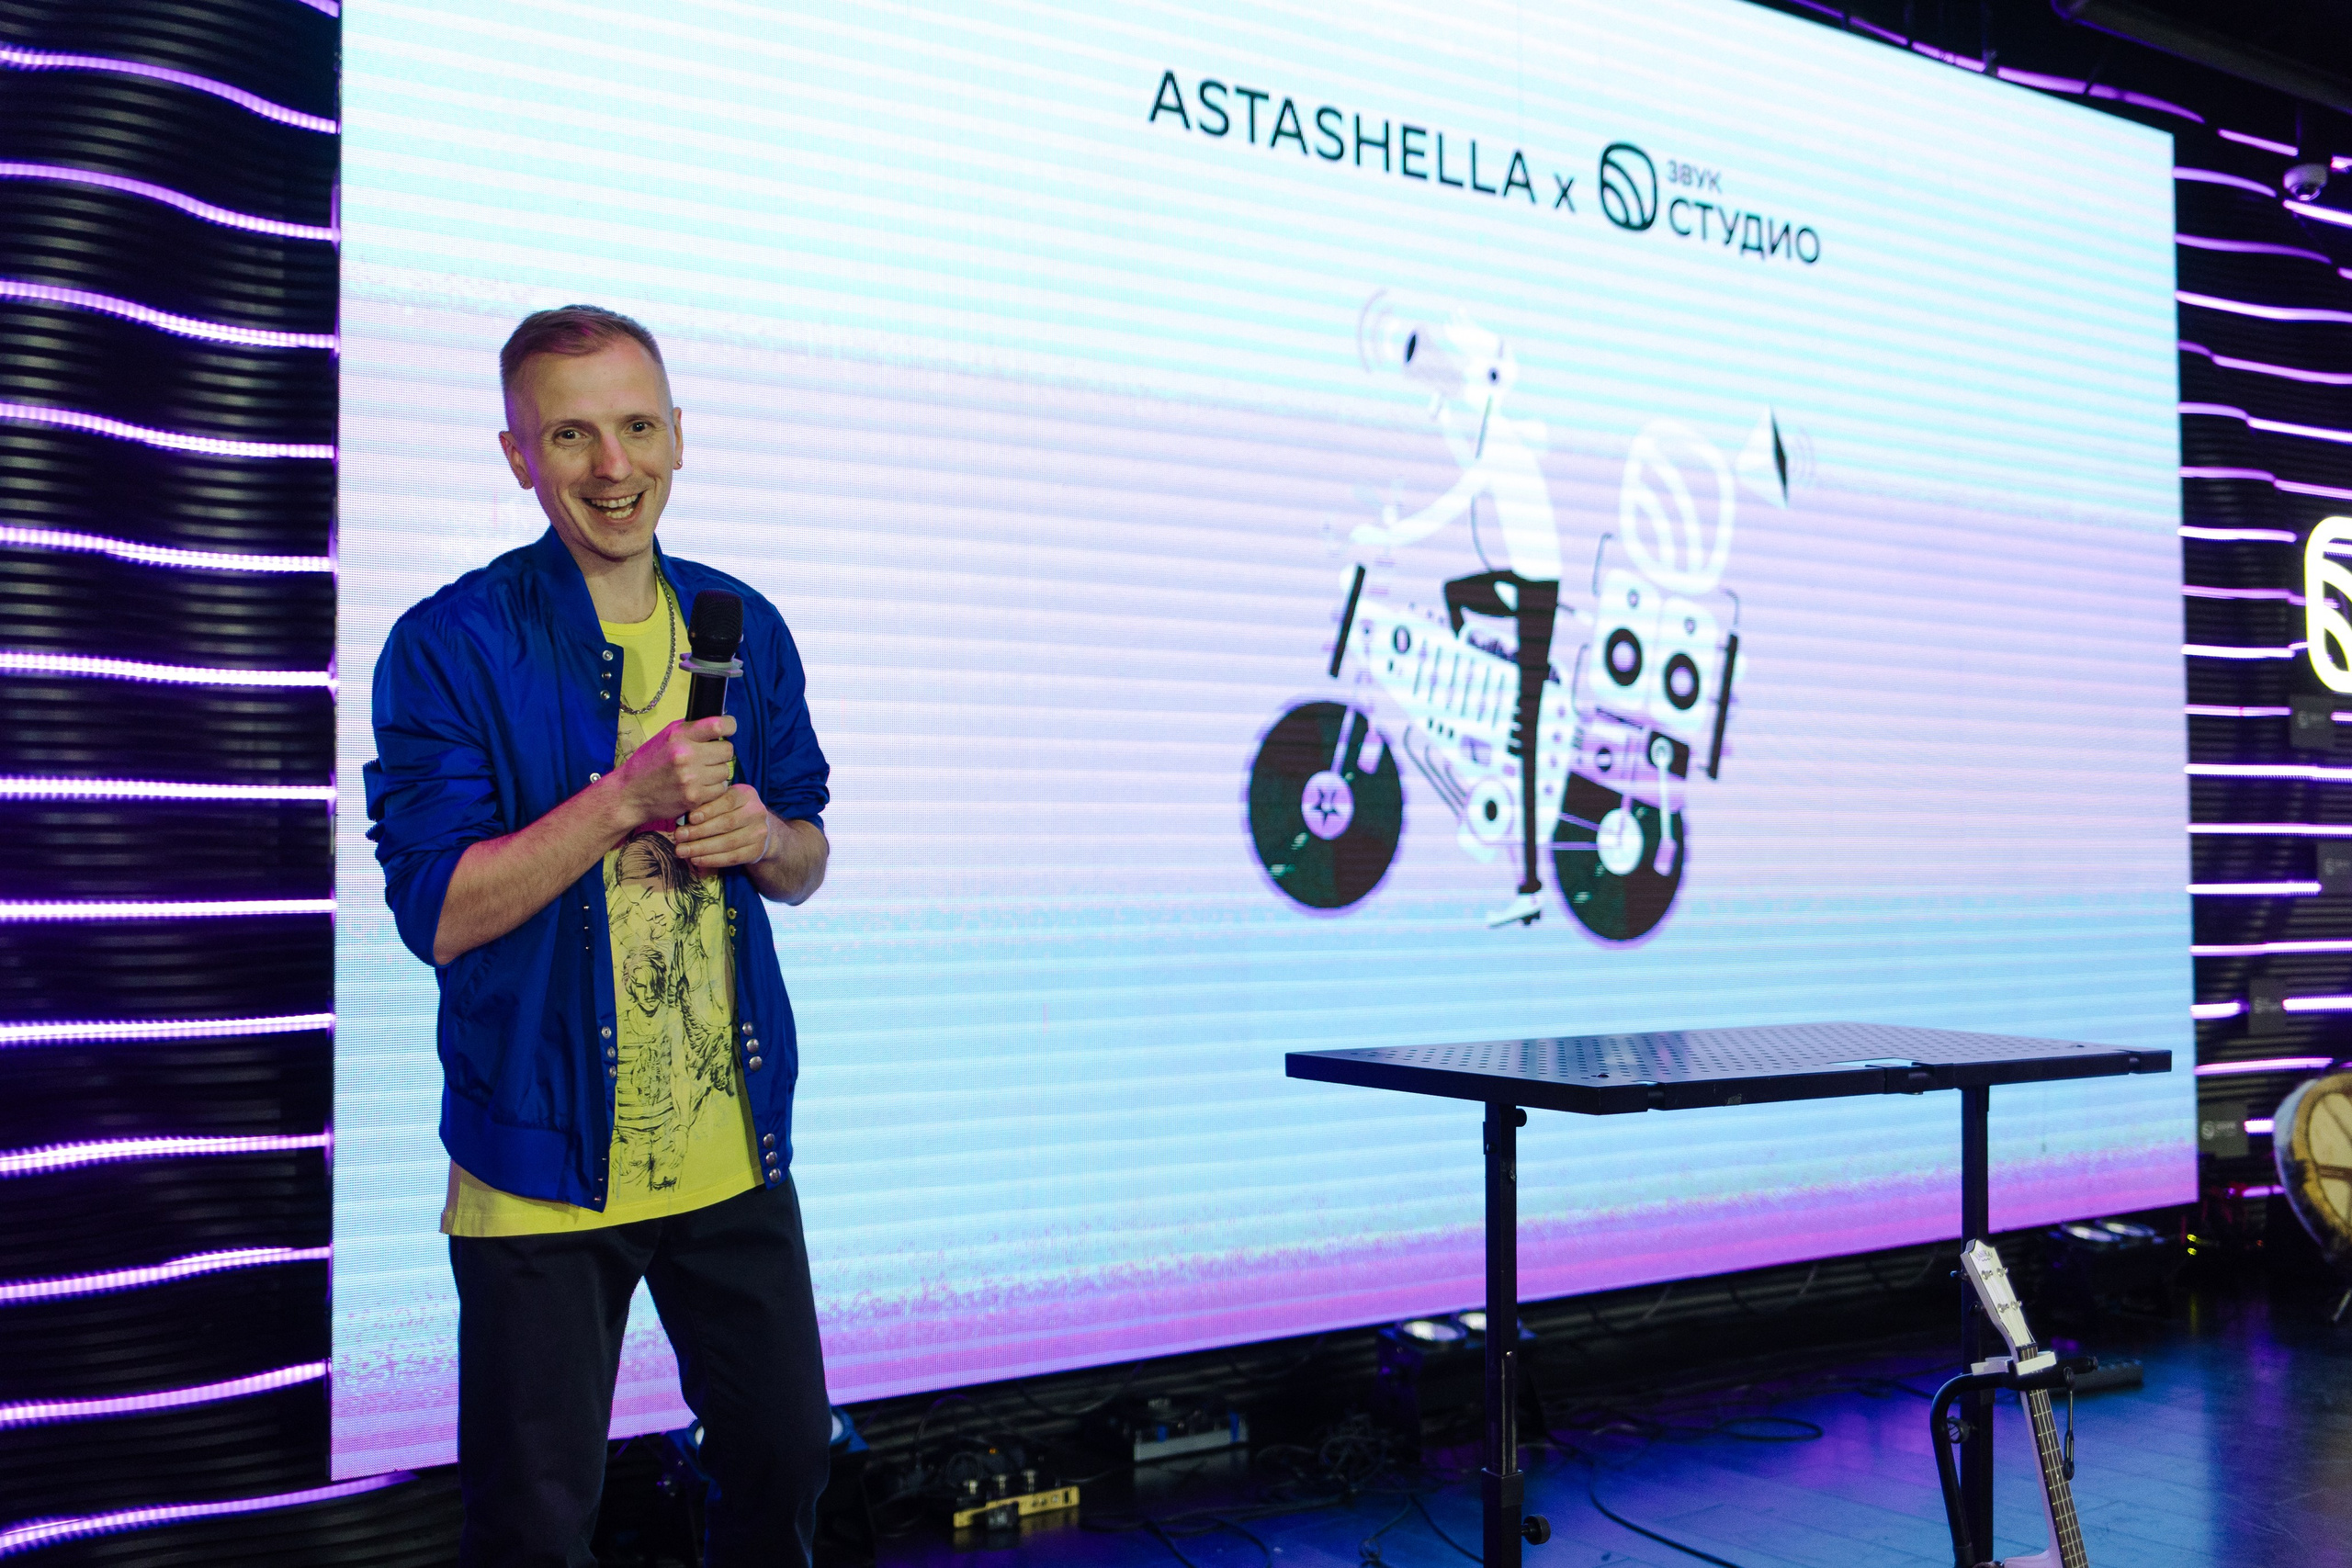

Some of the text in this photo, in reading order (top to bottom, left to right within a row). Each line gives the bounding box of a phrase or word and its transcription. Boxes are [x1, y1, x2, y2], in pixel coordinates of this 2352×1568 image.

[1149, 70, 1536, 204] ASTASHELLA
[1666, 159, 1723, 194] ЗВУК
[1669, 197, 1821, 264] СТУДИО
